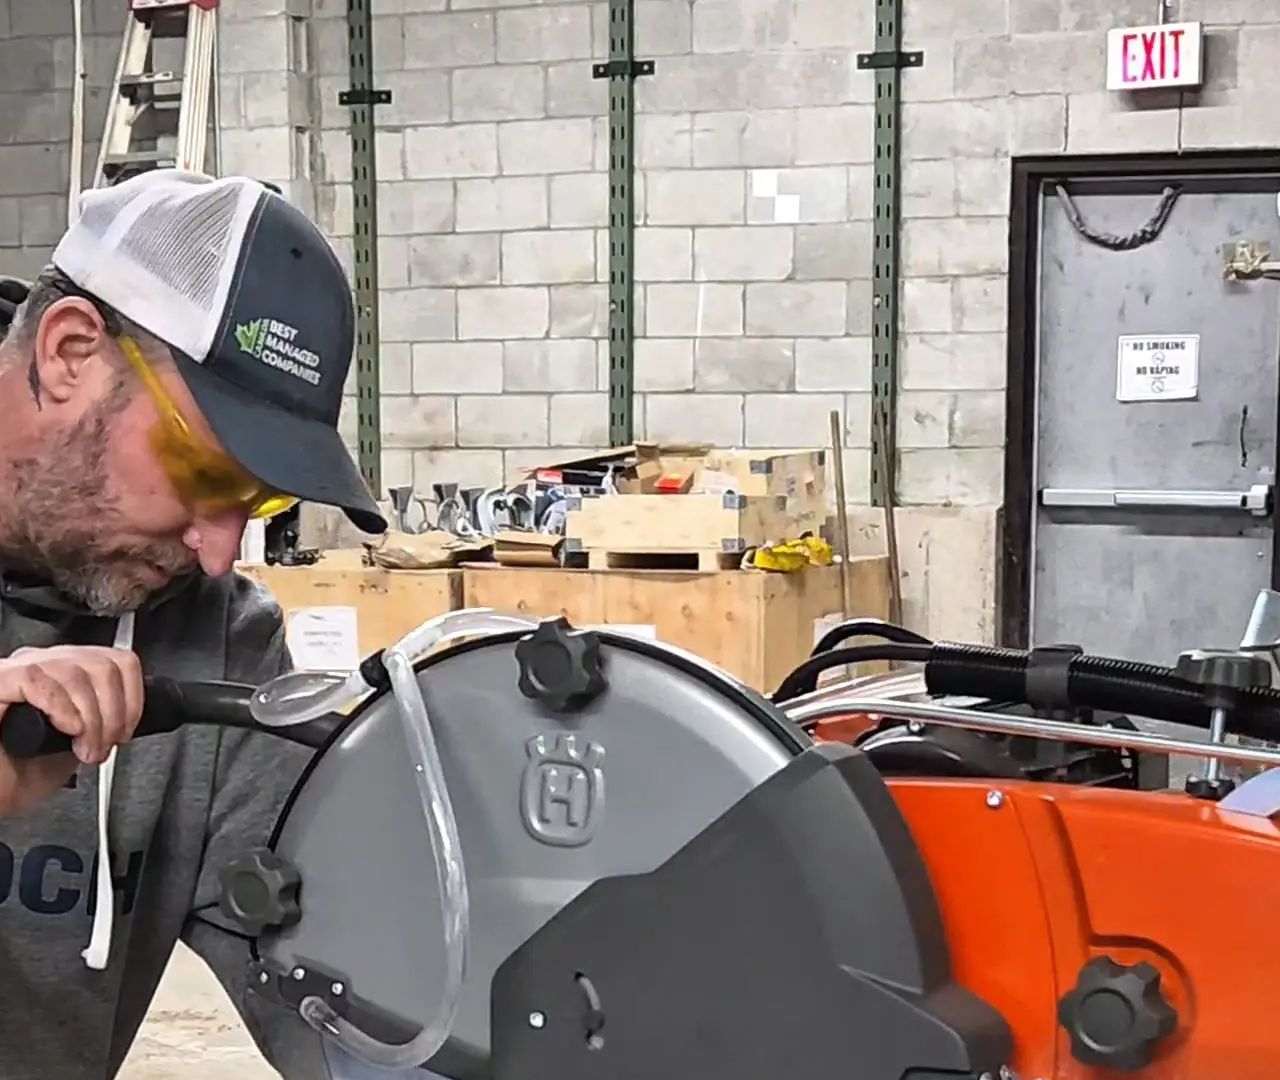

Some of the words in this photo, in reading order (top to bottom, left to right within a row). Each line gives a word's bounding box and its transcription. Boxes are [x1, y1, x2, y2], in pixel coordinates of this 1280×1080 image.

[1122, 30, 1185, 82] EXIT
[269, 319, 299, 341] BEST
[264, 334, 320, 368] MANAGED
[1133, 342, 1144, 350] NO
[1147, 341, 1186, 350] SMOKING
[261, 349, 321, 386] COMPANIES
[1136, 367, 1147, 375] NO
